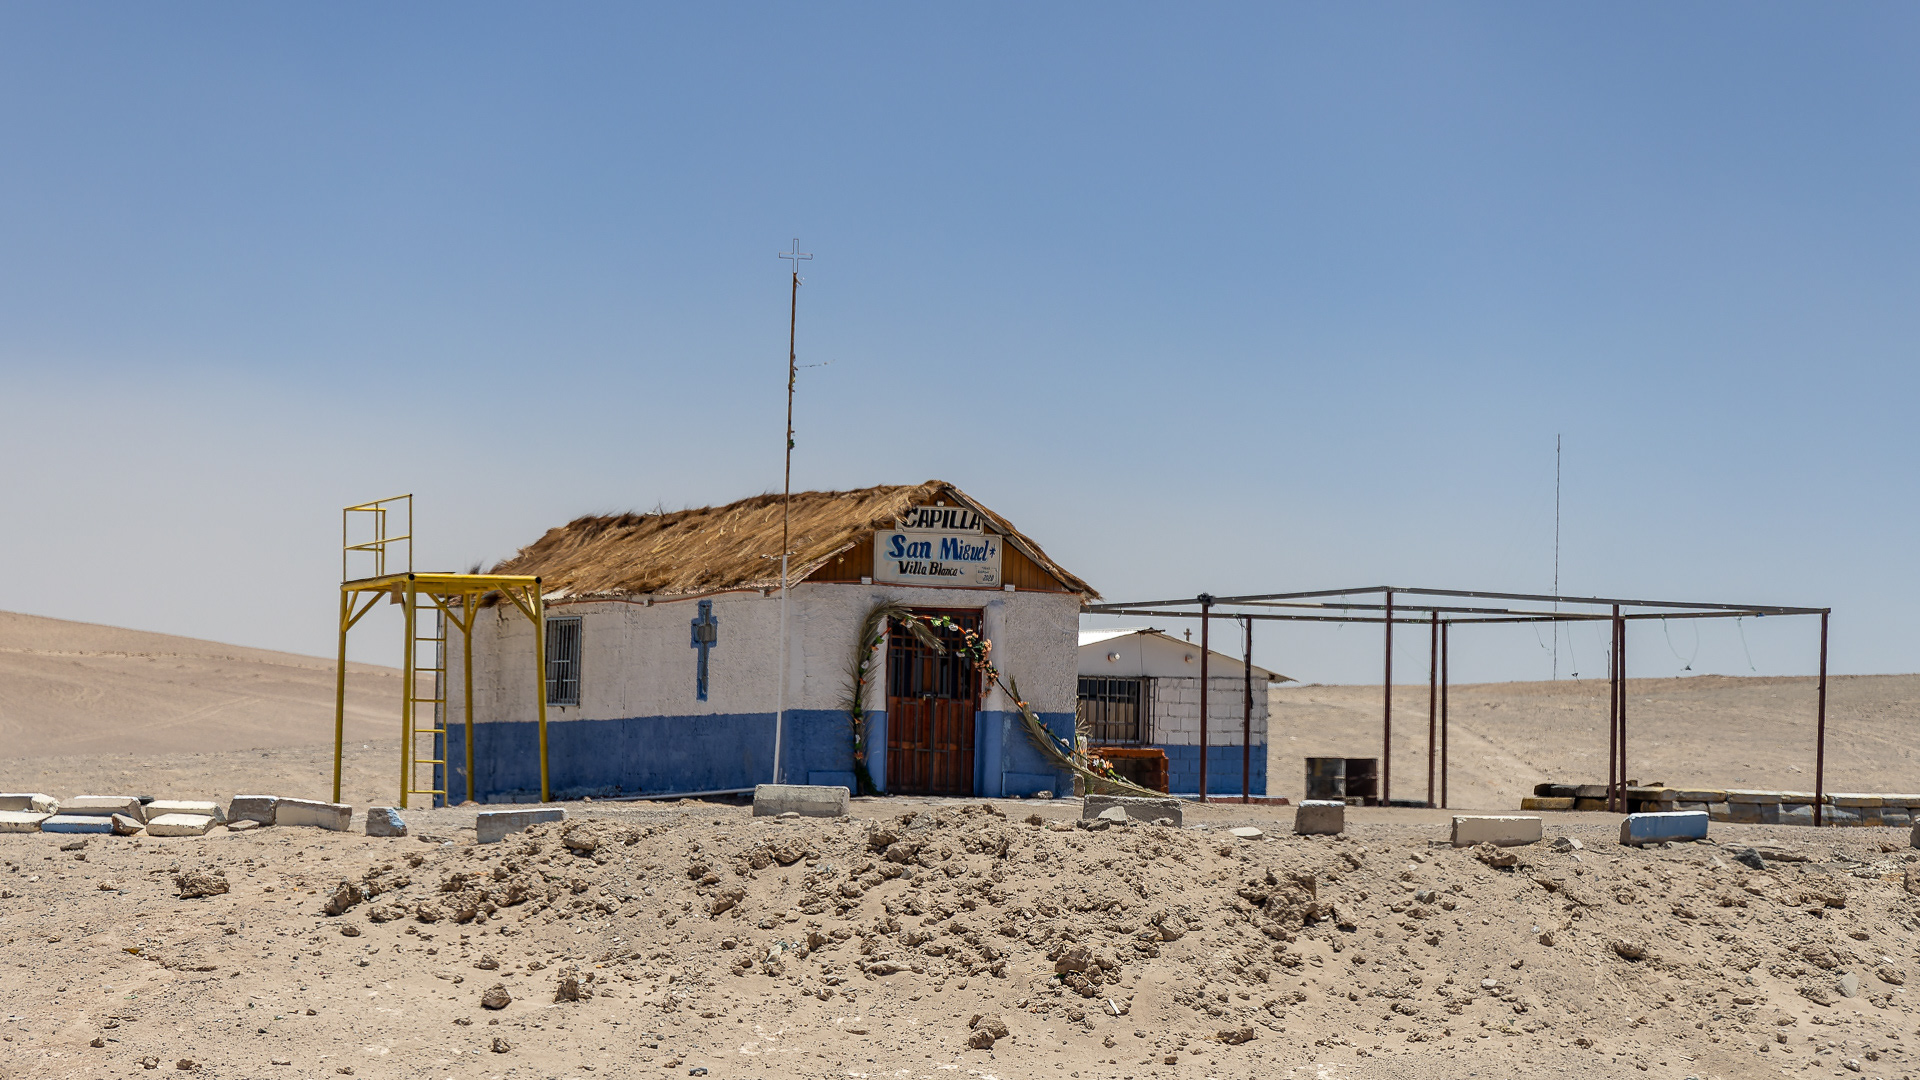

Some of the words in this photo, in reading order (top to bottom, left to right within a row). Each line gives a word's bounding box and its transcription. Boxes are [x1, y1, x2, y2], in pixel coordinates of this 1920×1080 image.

[901, 508, 980, 530] CAPILLA
[888, 535, 931, 559] San
[940, 537, 989, 561] Miguel
[898, 561, 927, 575] Villa
[928, 562, 958, 576] Blanca
